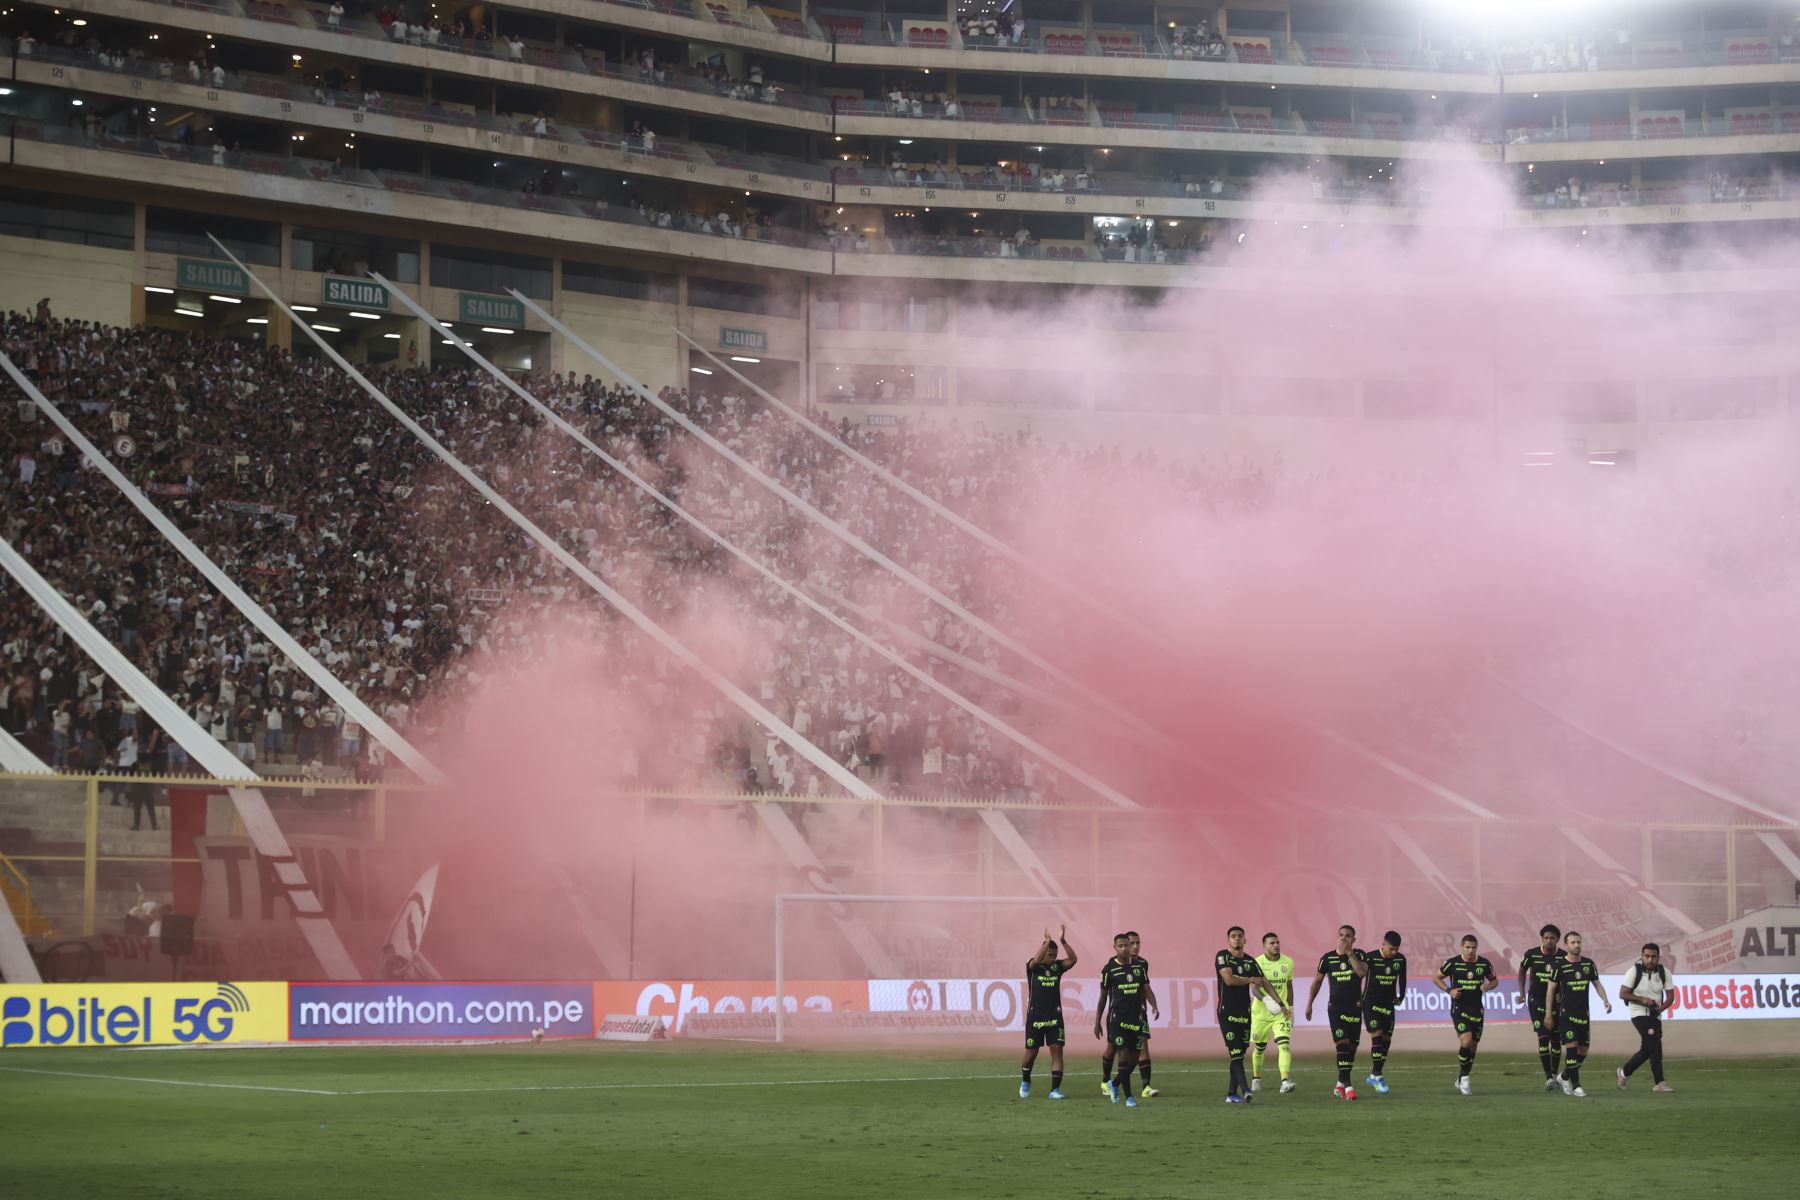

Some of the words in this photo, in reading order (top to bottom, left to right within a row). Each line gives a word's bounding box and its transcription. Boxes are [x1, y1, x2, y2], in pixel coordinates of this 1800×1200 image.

[860, 187, 871, 197] 153
[996, 193, 1006, 202] 157
[1065, 197, 1076, 205] 159
[1135, 199, 1145, 208] 161
[1741, 204, 1752, 213] 179
[186, 265, 244, 288] SALIDA
[329, 281, 384, 305] SALIDA
[467, 299, 520, 322] SALIDA
[725, 331, 764, 347] SALIDA
[300, 996, 584, 1028] marathon.com.pe
[39, 997, 152, 1044] bitel
[173, 998, 234, 1043] 5G
